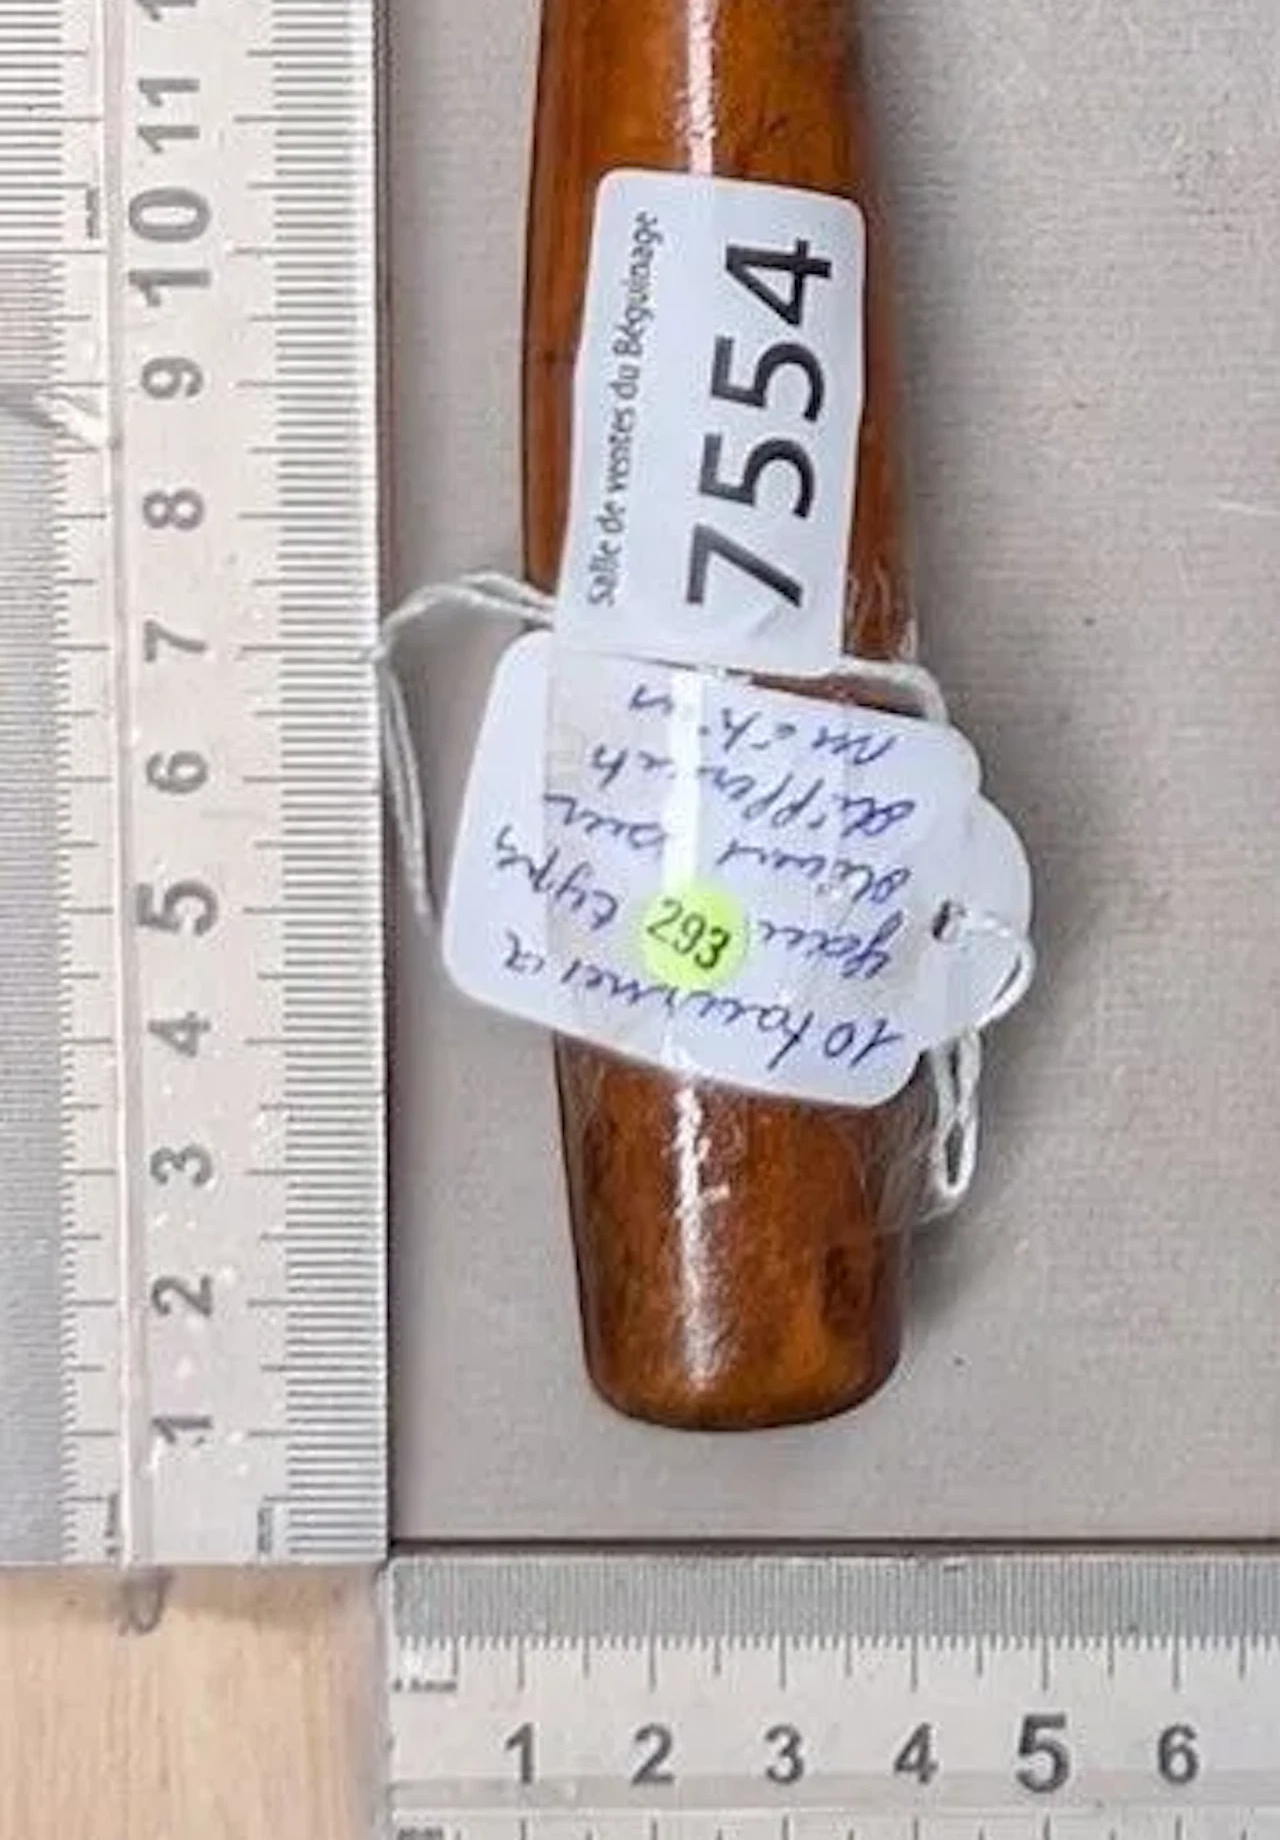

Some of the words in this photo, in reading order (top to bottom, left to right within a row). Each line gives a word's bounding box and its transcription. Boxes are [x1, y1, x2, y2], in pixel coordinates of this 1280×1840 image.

[136, 78, 199, 154] 11
[126, 188, 211, 307] 10
[612, 210, 663, 361] Béguinage
[140, 357, 203, 399] 9
[608, 366, 640, 402] du
[685, 239, 832, 608] 7554
[606, 405, 636, 497] ventes
[142, 489, 204, 530] 8
[596, 500, 626, 534] de
[586, 539, 622, 608] Salle
[143, 621, 207, 663] 7
[146, 752, 208, 794] 6
[135, 881, 218, 936] 5
[646, 897, 733, 970] 293
[148, 1012, 210, 1057] 4
[822, 1017, 903, 1067] 10
[150, 1145, 213, 1187] 3
[150, 1275, 213, 1318] 2
[151, 1416, 213, 1445] 1
[505, 1723, 534, 1786] 1
[632, 1723, 674, 1786] 2
[765, 1725, 804, 1786] 3
[894, 1723, 938, 1785] 4
[1016, 1713, 1070, 1794] 5
[1157, 1723, 1199, 1786] 6
